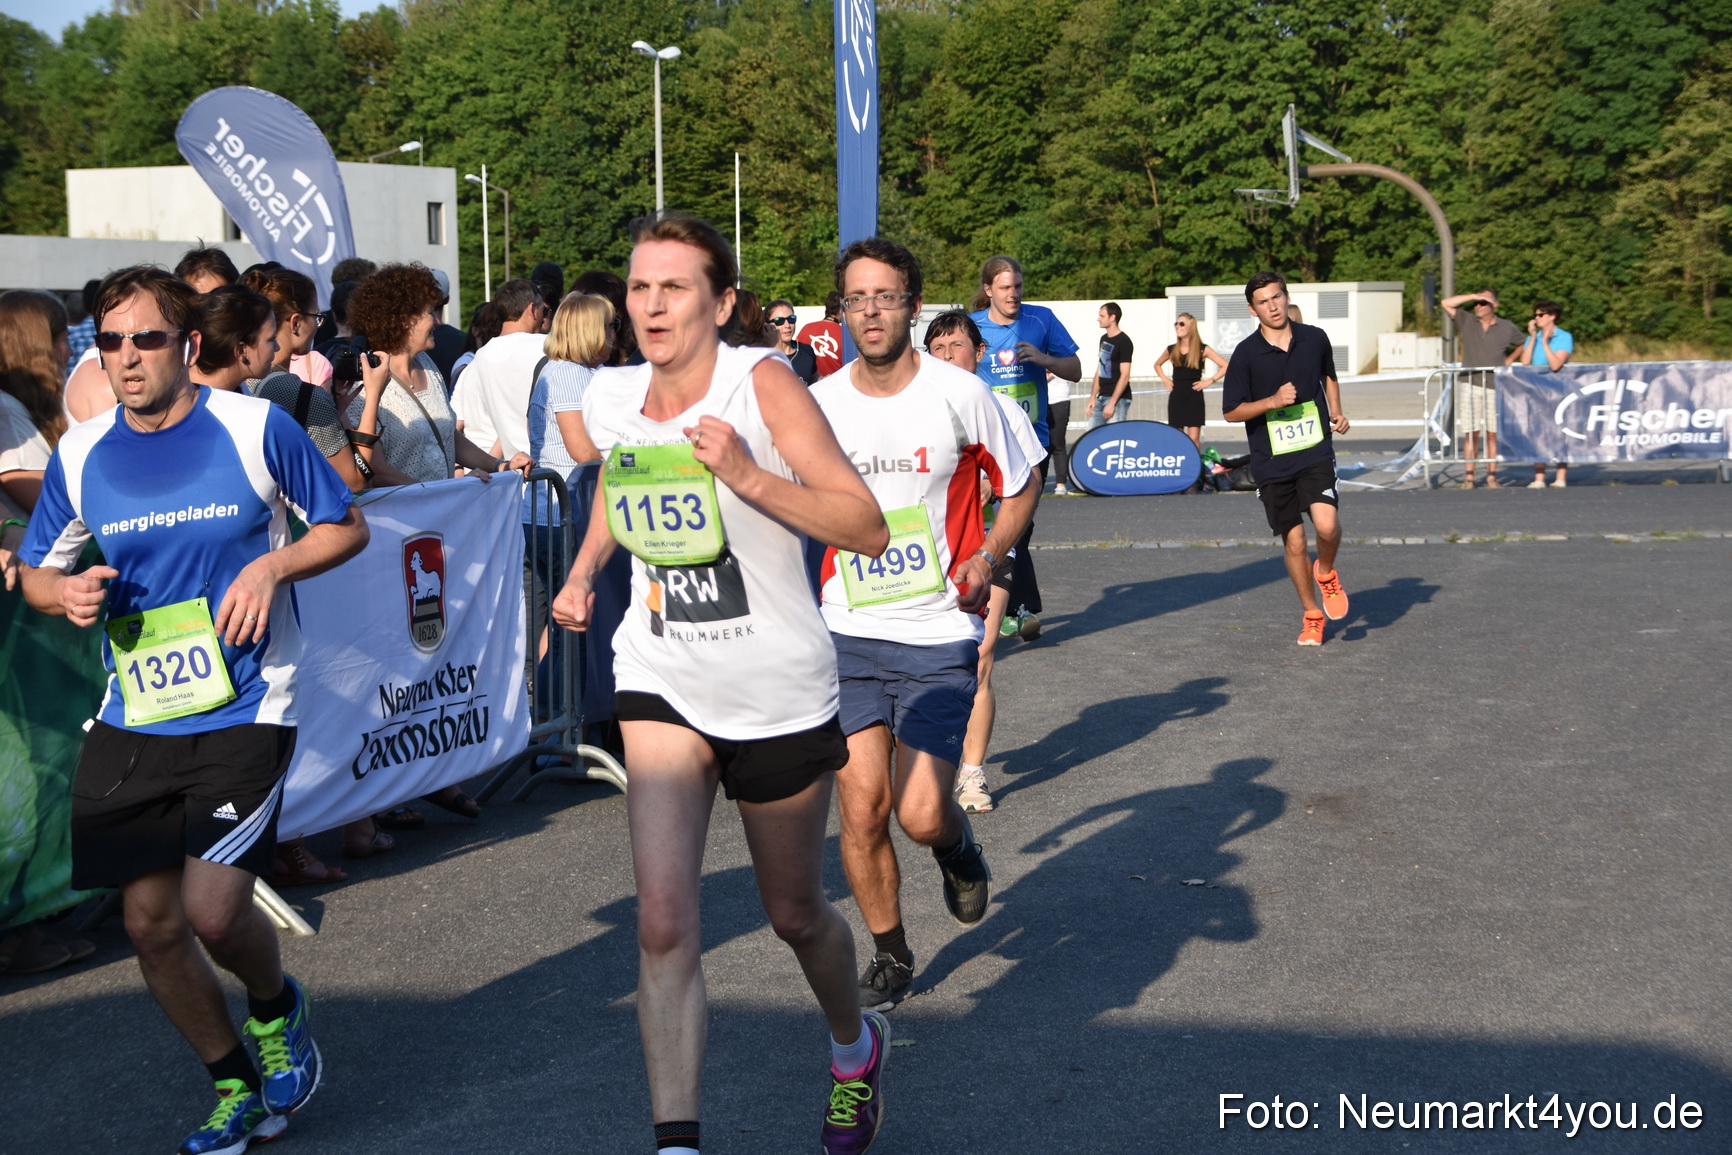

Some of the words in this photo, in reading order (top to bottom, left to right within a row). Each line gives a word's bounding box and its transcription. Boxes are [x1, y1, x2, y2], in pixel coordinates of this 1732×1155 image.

[991, 364, 1024, 376] camping
[1586, 401, 1732, 432] Fischer
[1275, 420, 1314, 441] 1317
[1599, 431, 1723, 447] AUTOMOBILE
[354, 453, 371, 475] SONY
[1106, 452, 1186, 471] Fischer
[1114, 468, 1182, 479] AUTOMOBILE
[101, 503, 239, 535] energiegeladen
[615, 493, 706, 532] 1153
[660, 540, 686, 548] Krieger
[849, 543, 926, 582] 1499
[667, 567, 719, 604] RW
[871, 584, 884, 592] Nick
[418, 623, 438, 642] 1628
[670, 624, 755, 642] RAUMWERK
[128, 646, 211, 693] 1320
[156, 693, 177, 704] Roland
[178, 691, 195, 699] Haas
[212, 812, 239, 821] adidas
